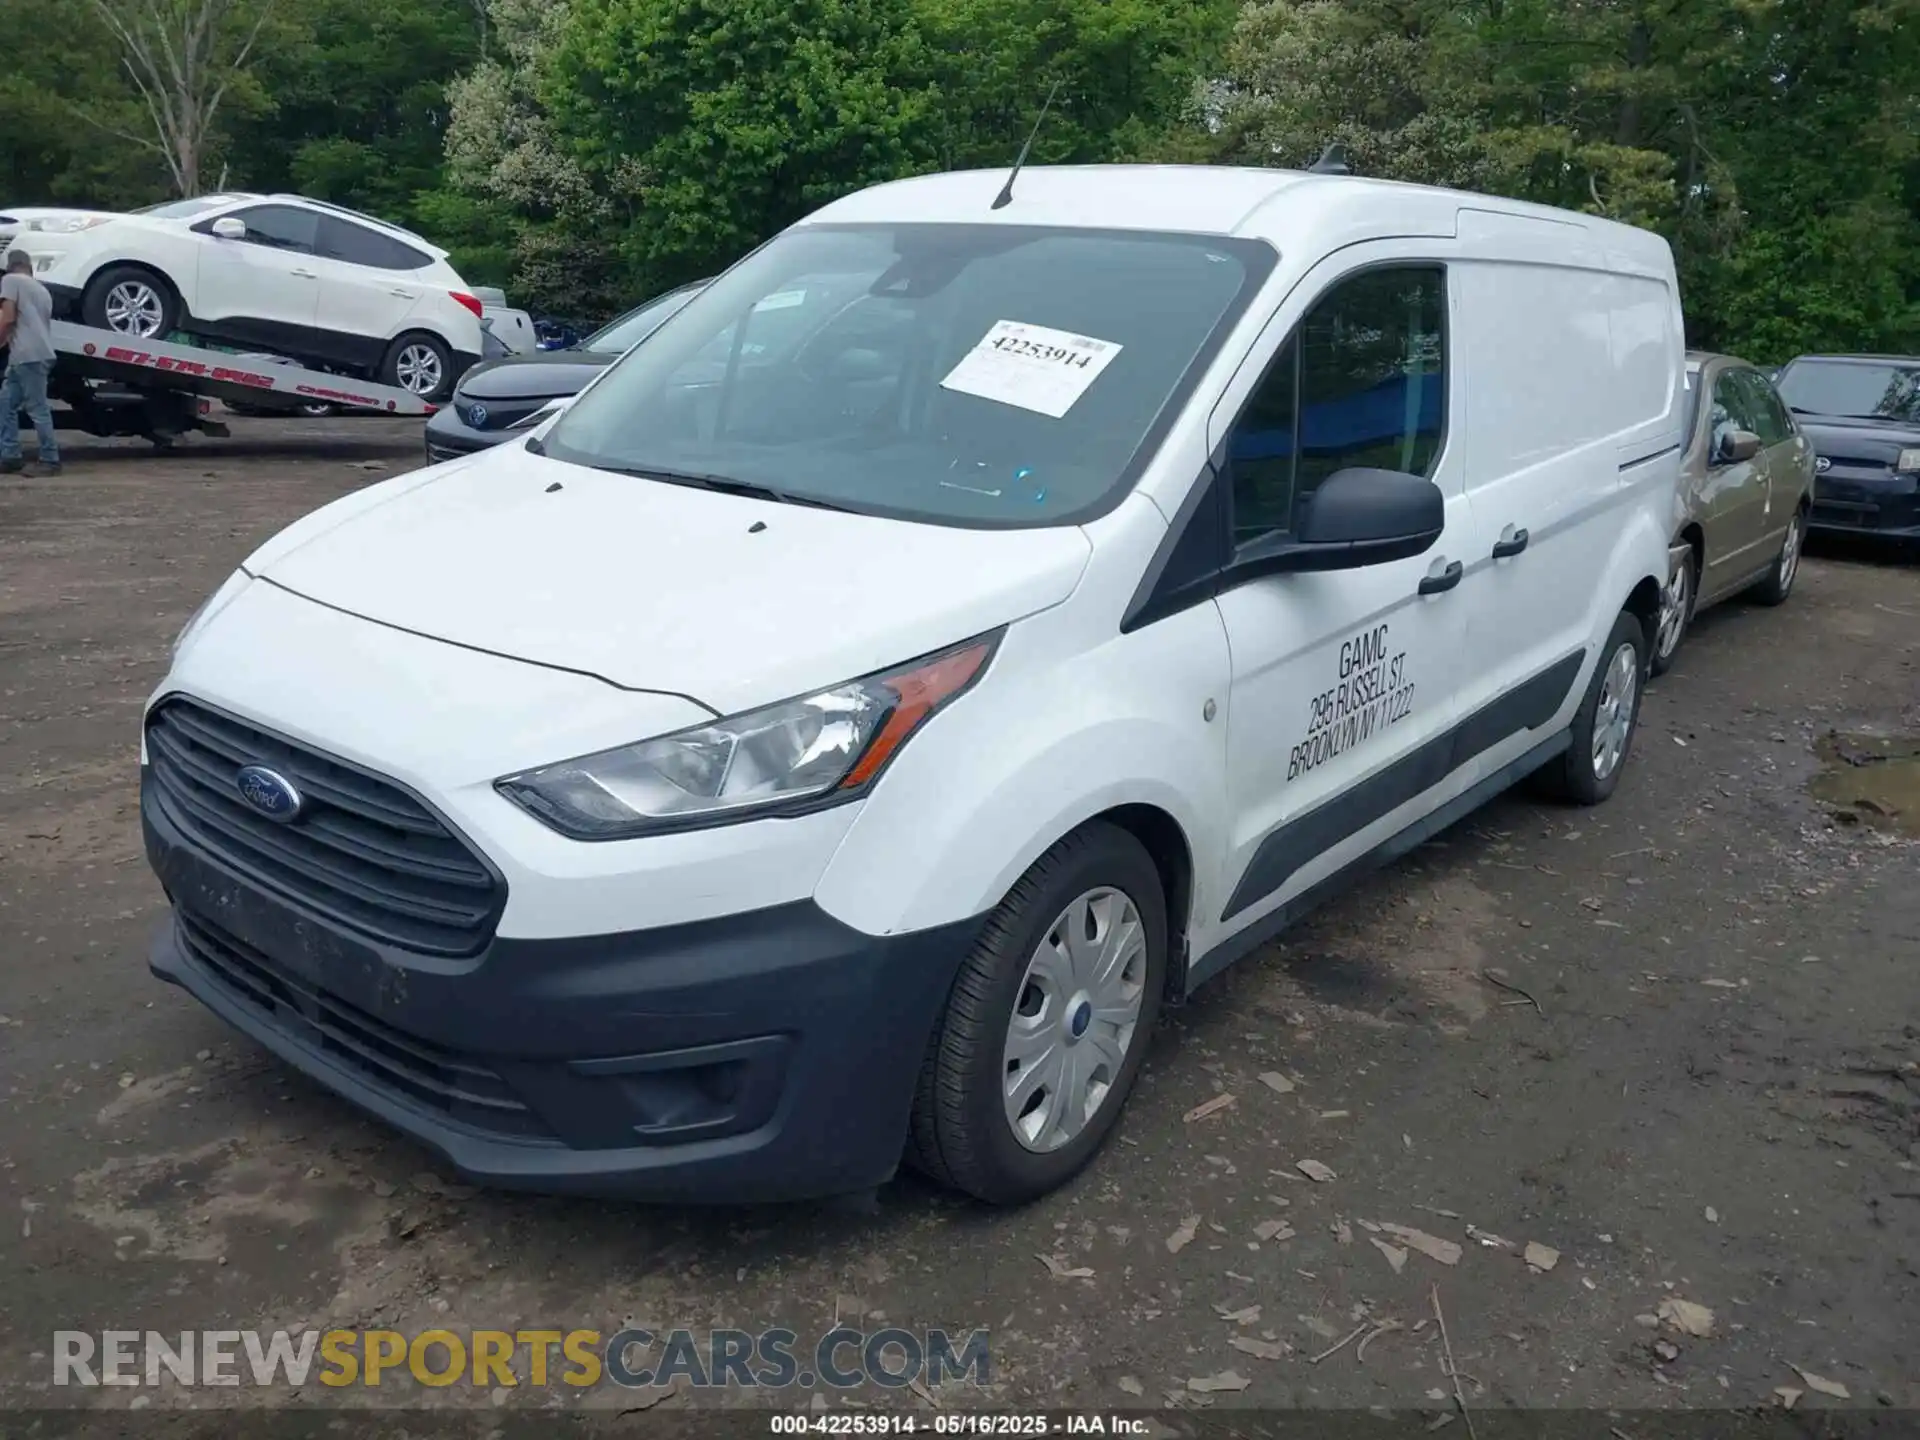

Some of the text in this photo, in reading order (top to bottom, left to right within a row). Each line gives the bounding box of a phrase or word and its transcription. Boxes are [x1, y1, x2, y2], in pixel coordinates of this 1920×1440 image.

[991, 336, 1093, 369] 42253914
[1339, 624, 1388, 679] GAMC
[1308, 689, 1335, 735] 295
[1336, 662, 1386, 720] RUSSELL
[1287, 683, 1415, 782] BROOKLYN NY 11222
[245, 774, 280, 809] Ford
